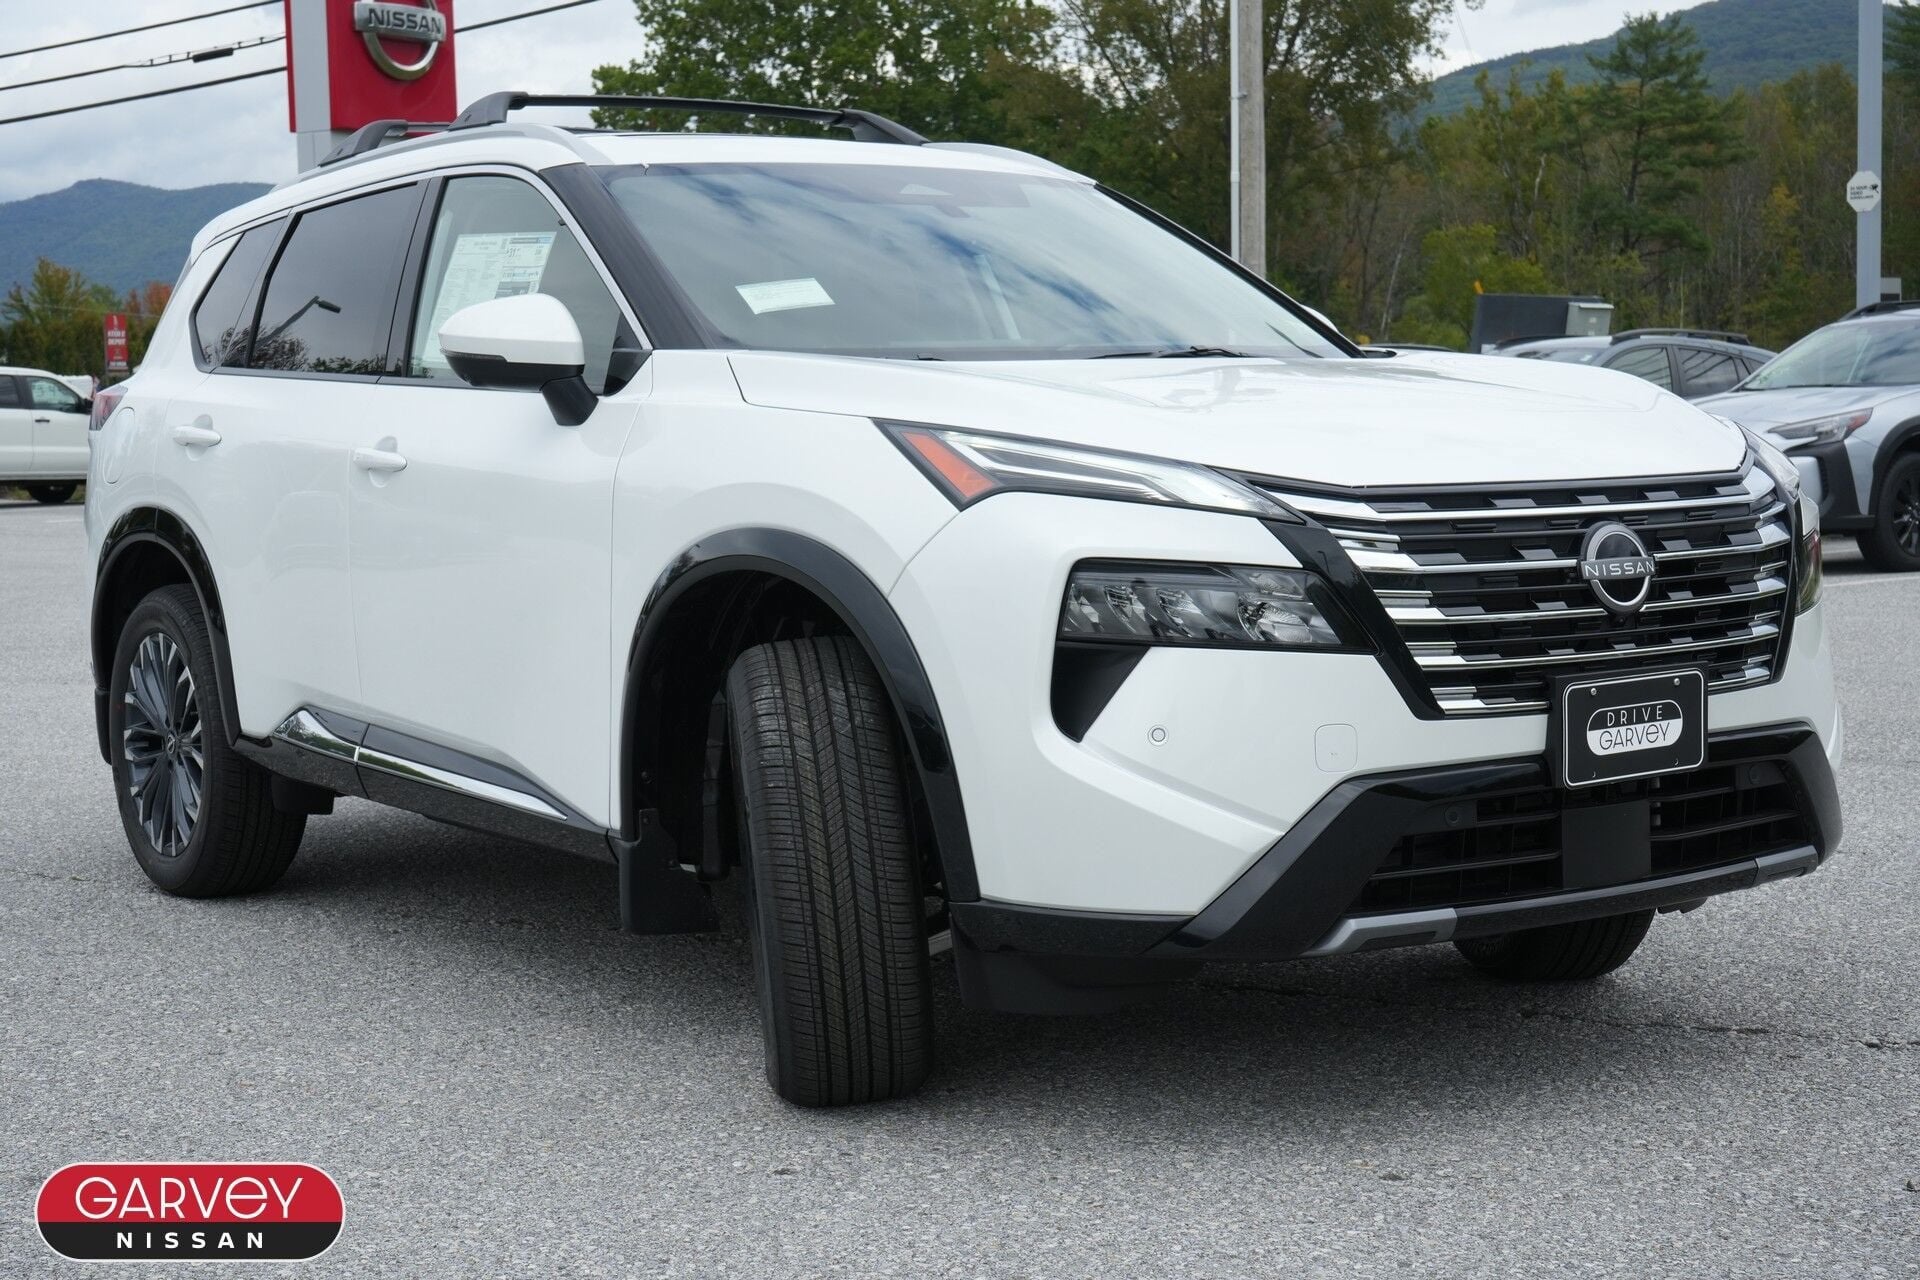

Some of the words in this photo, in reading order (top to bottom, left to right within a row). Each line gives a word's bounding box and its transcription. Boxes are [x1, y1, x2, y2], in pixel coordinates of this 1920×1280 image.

[368, 8, 441, 35] NISSAN
[1584, 561, 1655, 577] NISSAN
[1607, 705, 1663, 727] DRIVE
